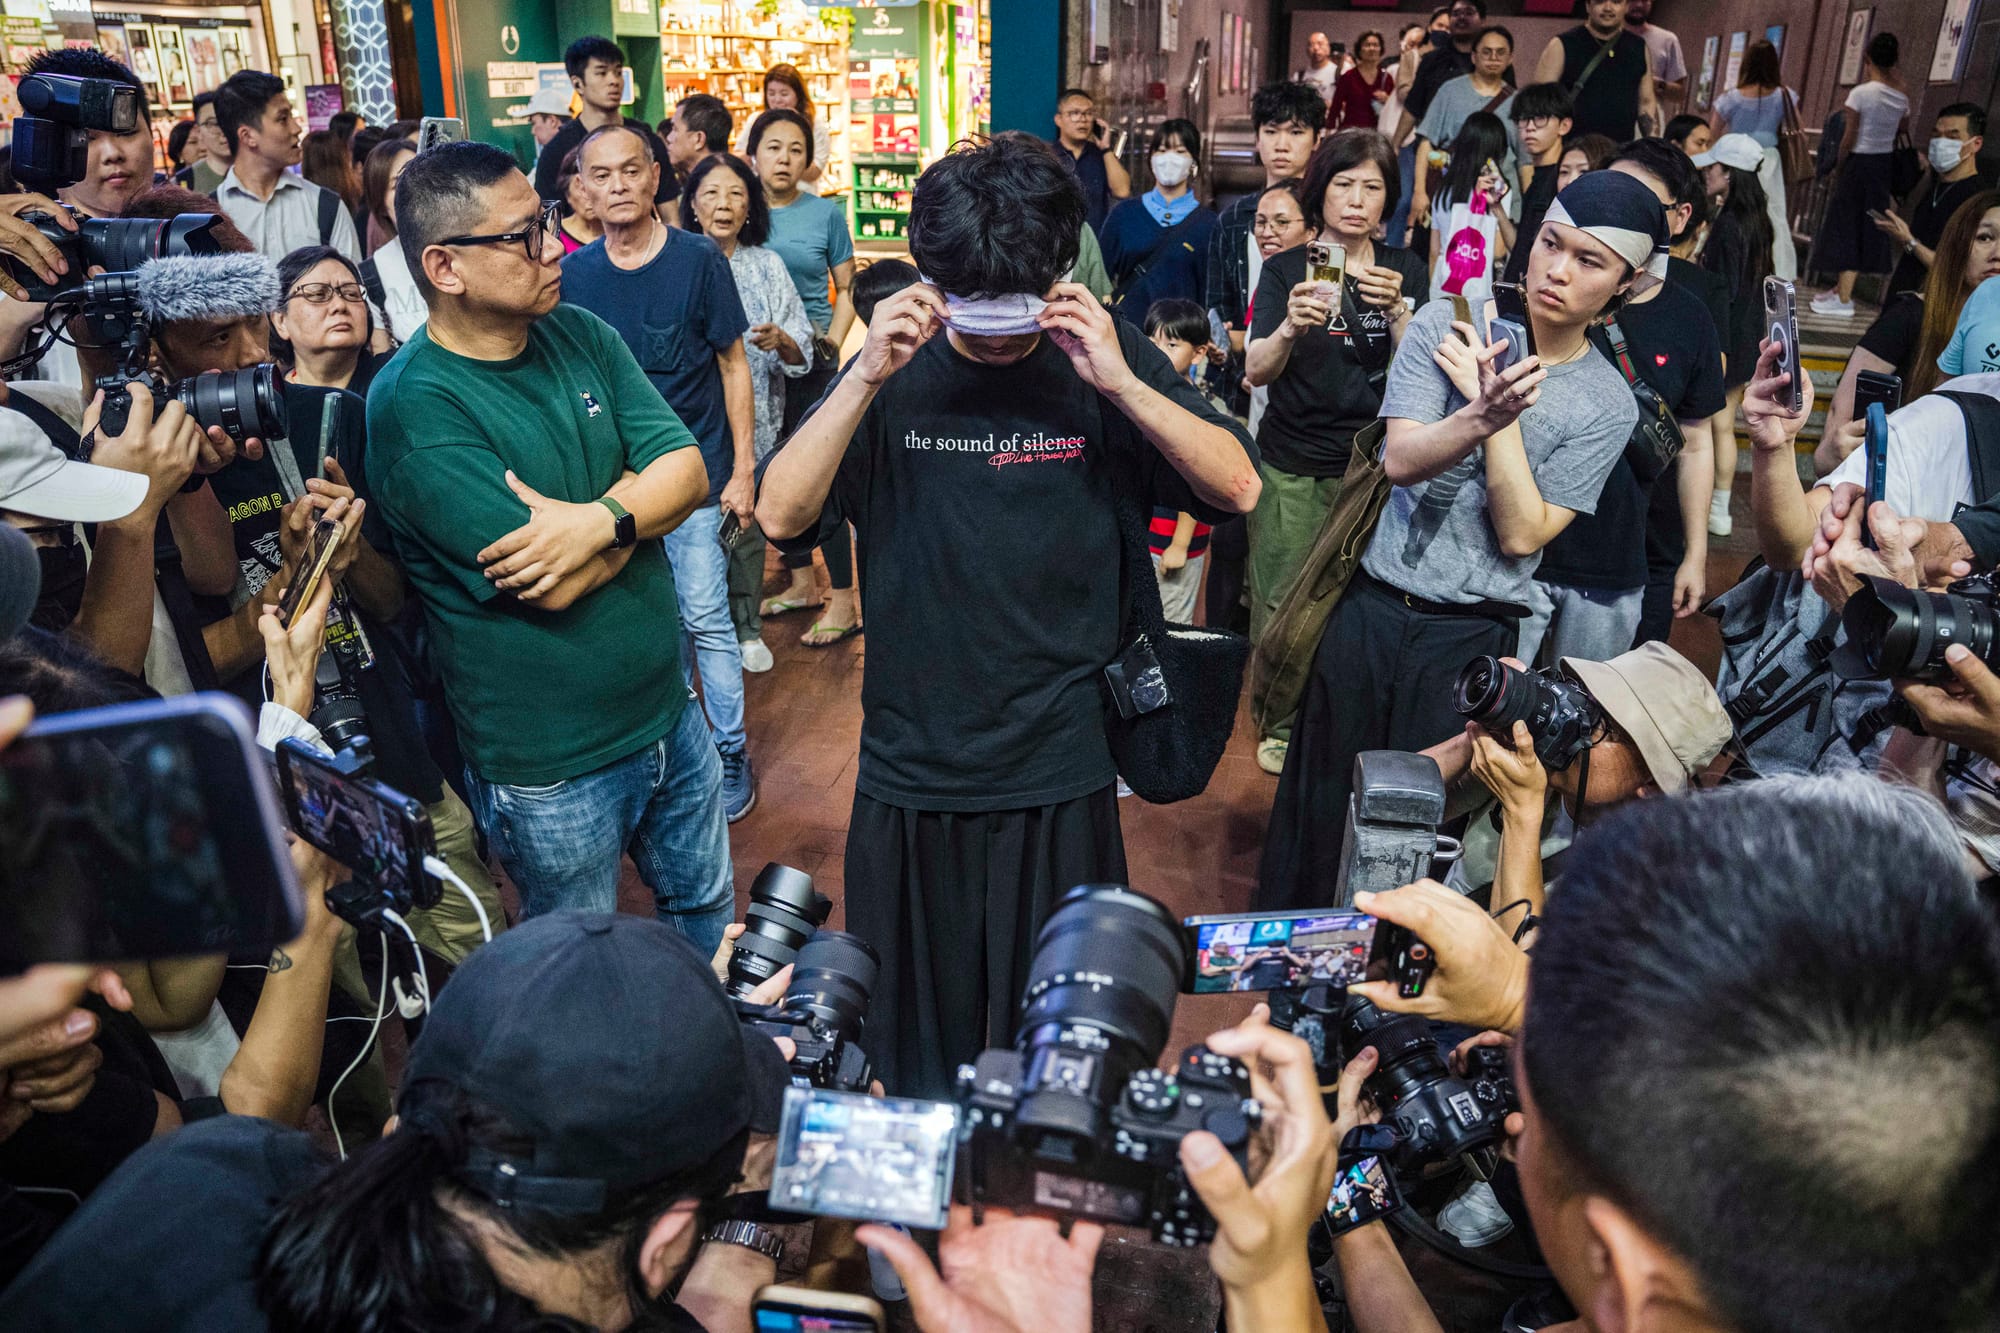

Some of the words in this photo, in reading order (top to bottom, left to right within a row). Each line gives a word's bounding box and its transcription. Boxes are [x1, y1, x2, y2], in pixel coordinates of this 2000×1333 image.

[904, 430, 932, 450] the
[936, 433, 995, 452] sound
[999, 432, 1021, 452] of
[1022, 432, 1086, 452] silence
